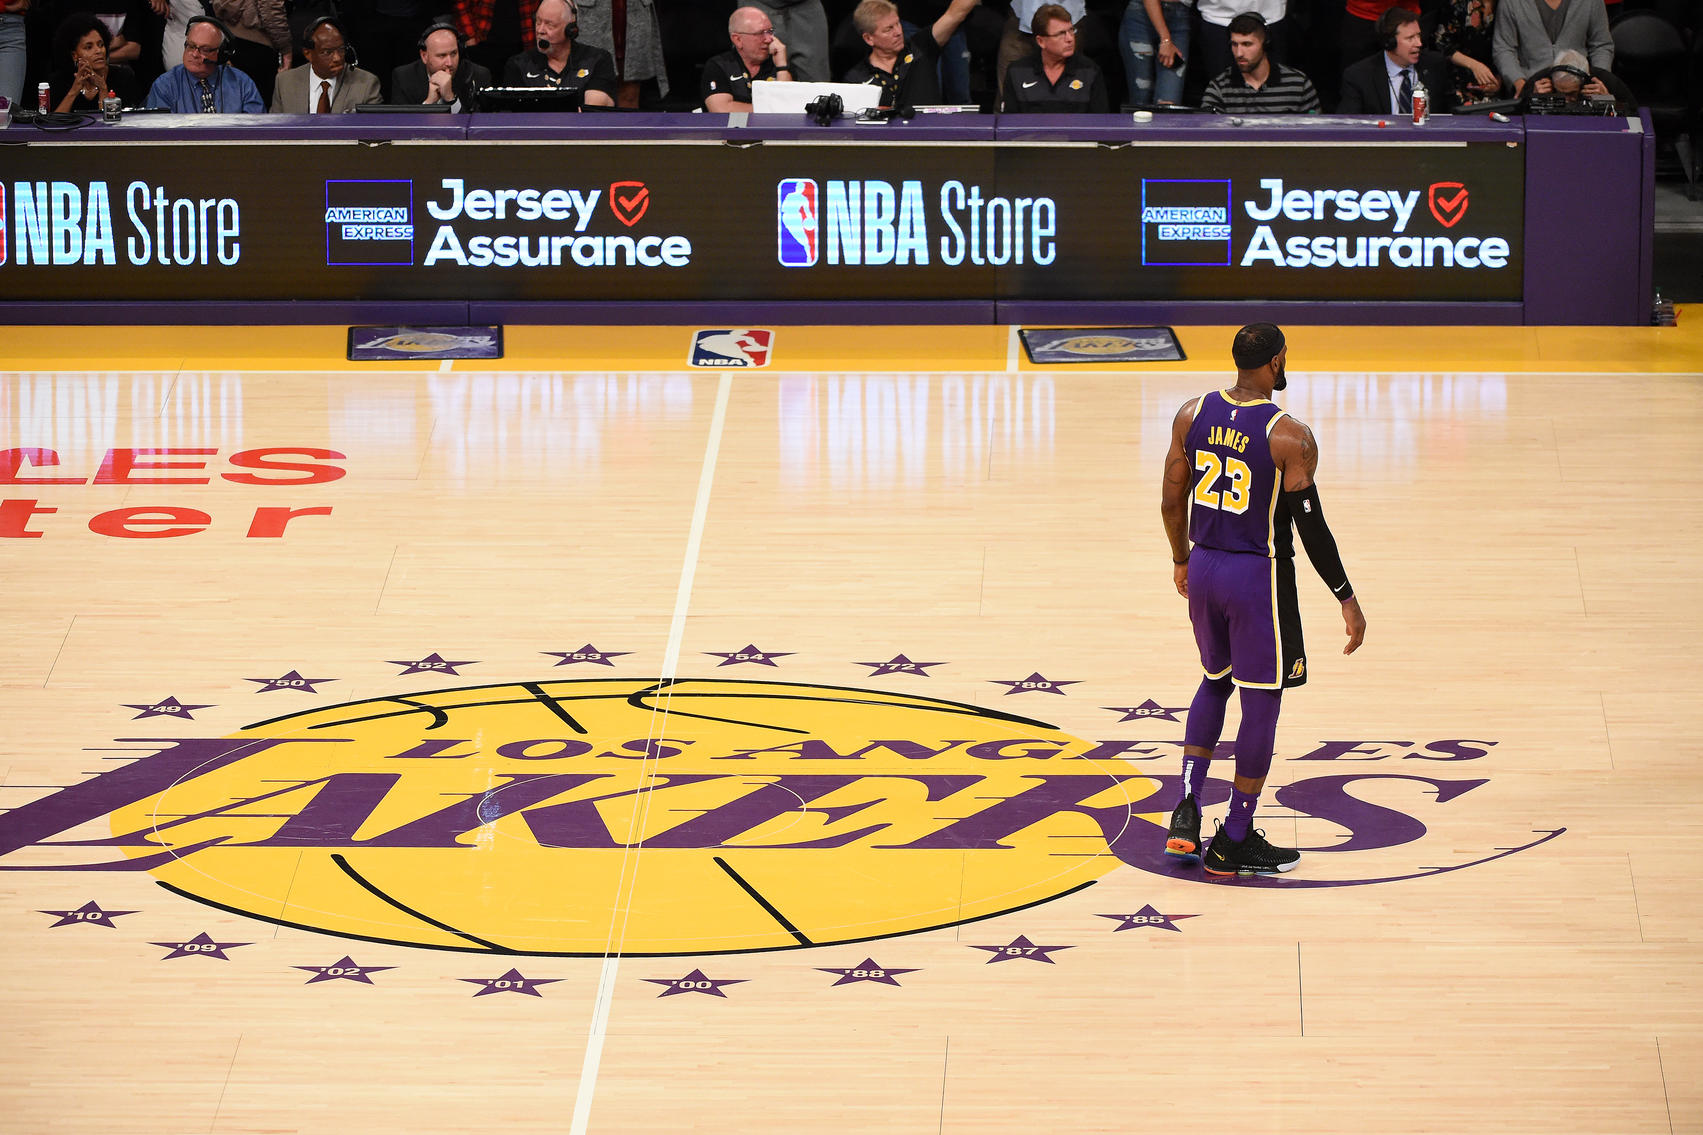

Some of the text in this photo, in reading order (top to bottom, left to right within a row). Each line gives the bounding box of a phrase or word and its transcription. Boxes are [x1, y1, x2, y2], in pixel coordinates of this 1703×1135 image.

[426, 178, 602, 232] Jersey
[1244, 178, 1422, 233] Jersey
[14, 180, 241, 266] NBA Store
[325, 207, 408, 223] AMERICAN
[1141, 207, 1226, 223] AMERICAN
[826, 180, 1057, 267] NBA Store
[342, 225, 414, 241] EXPRESS
[1158, 225, 1232, 241] EXPRESS
[423, 225, 693, 268] Assurance
[1239, 225, 1511, 269] Assurance
[698, 358, 744, 366] NBA
[1207, 425, 1250, 454] JAMES
[1194, 449, 1253, 516] 23
[0, 499, 334, 539] ter
[1015, 681, 1051, 689] '80
[384, 738, 697, 761] LOS
[67, 911, 103, 920] '10
[1125, 915, 1165, 923] '85
[177, 943, 217, 952] '09
[998, 947, 1039, 955] '87
[321, 967, 360, 976] '02
[844, 969, 885, 978] '88
[487, 980, 524, 989] '01
[671, 980, 712, 989] '00
